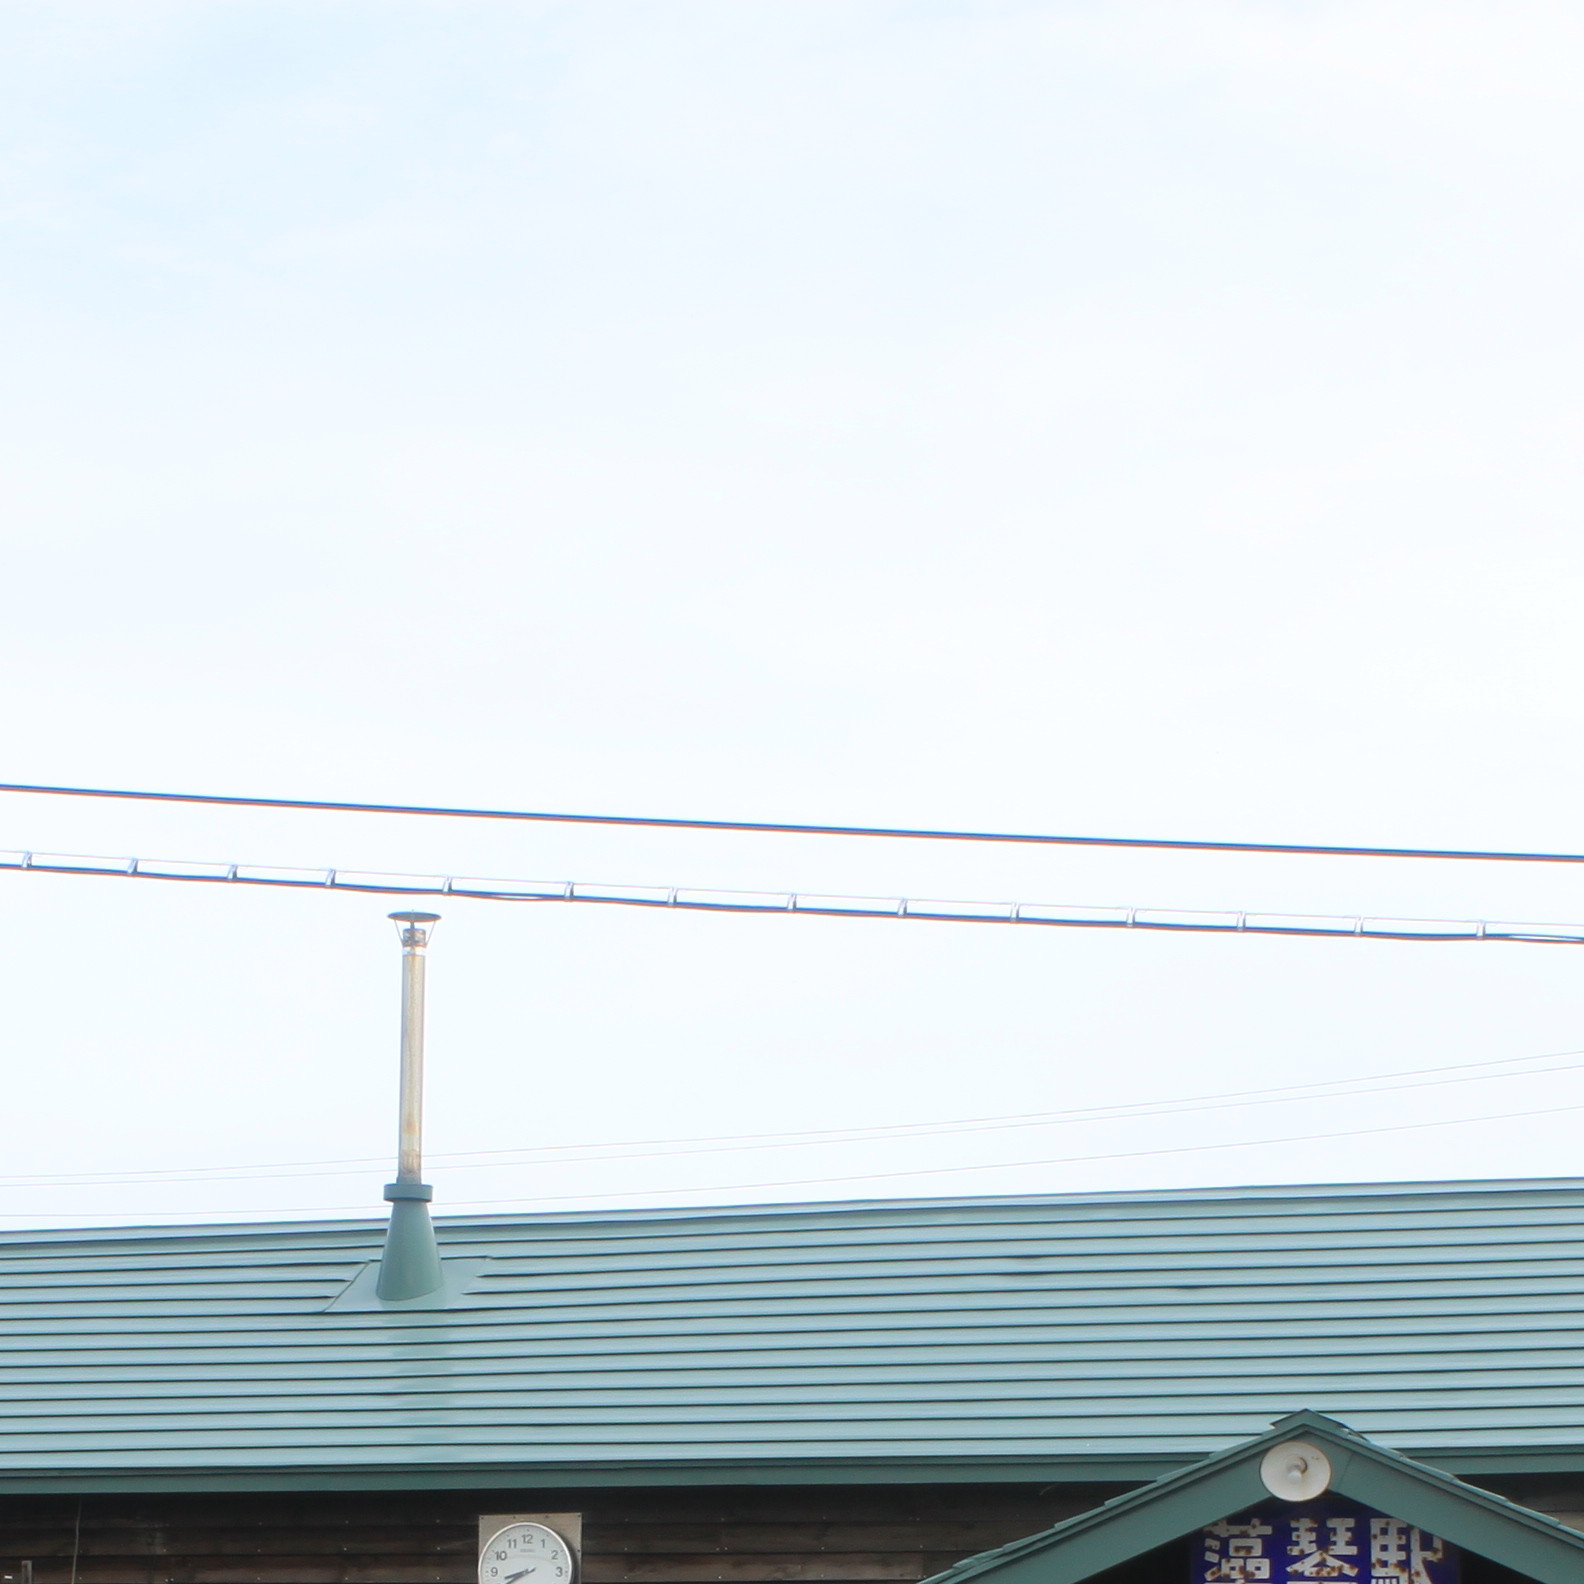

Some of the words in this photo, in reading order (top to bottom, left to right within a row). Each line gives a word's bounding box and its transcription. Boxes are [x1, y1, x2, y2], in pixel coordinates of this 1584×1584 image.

[507, 1538, 517, 1549] 11
[521, 1534, 533, 1545] 12
[540, 1539, 546, 1549] 1
[495, 1550, 508, 1561] 10
[551, 1550, 559, 1561] 2
[490, 1567, 498, 1577] 9
[555, 1566, 563, 1577] 3
